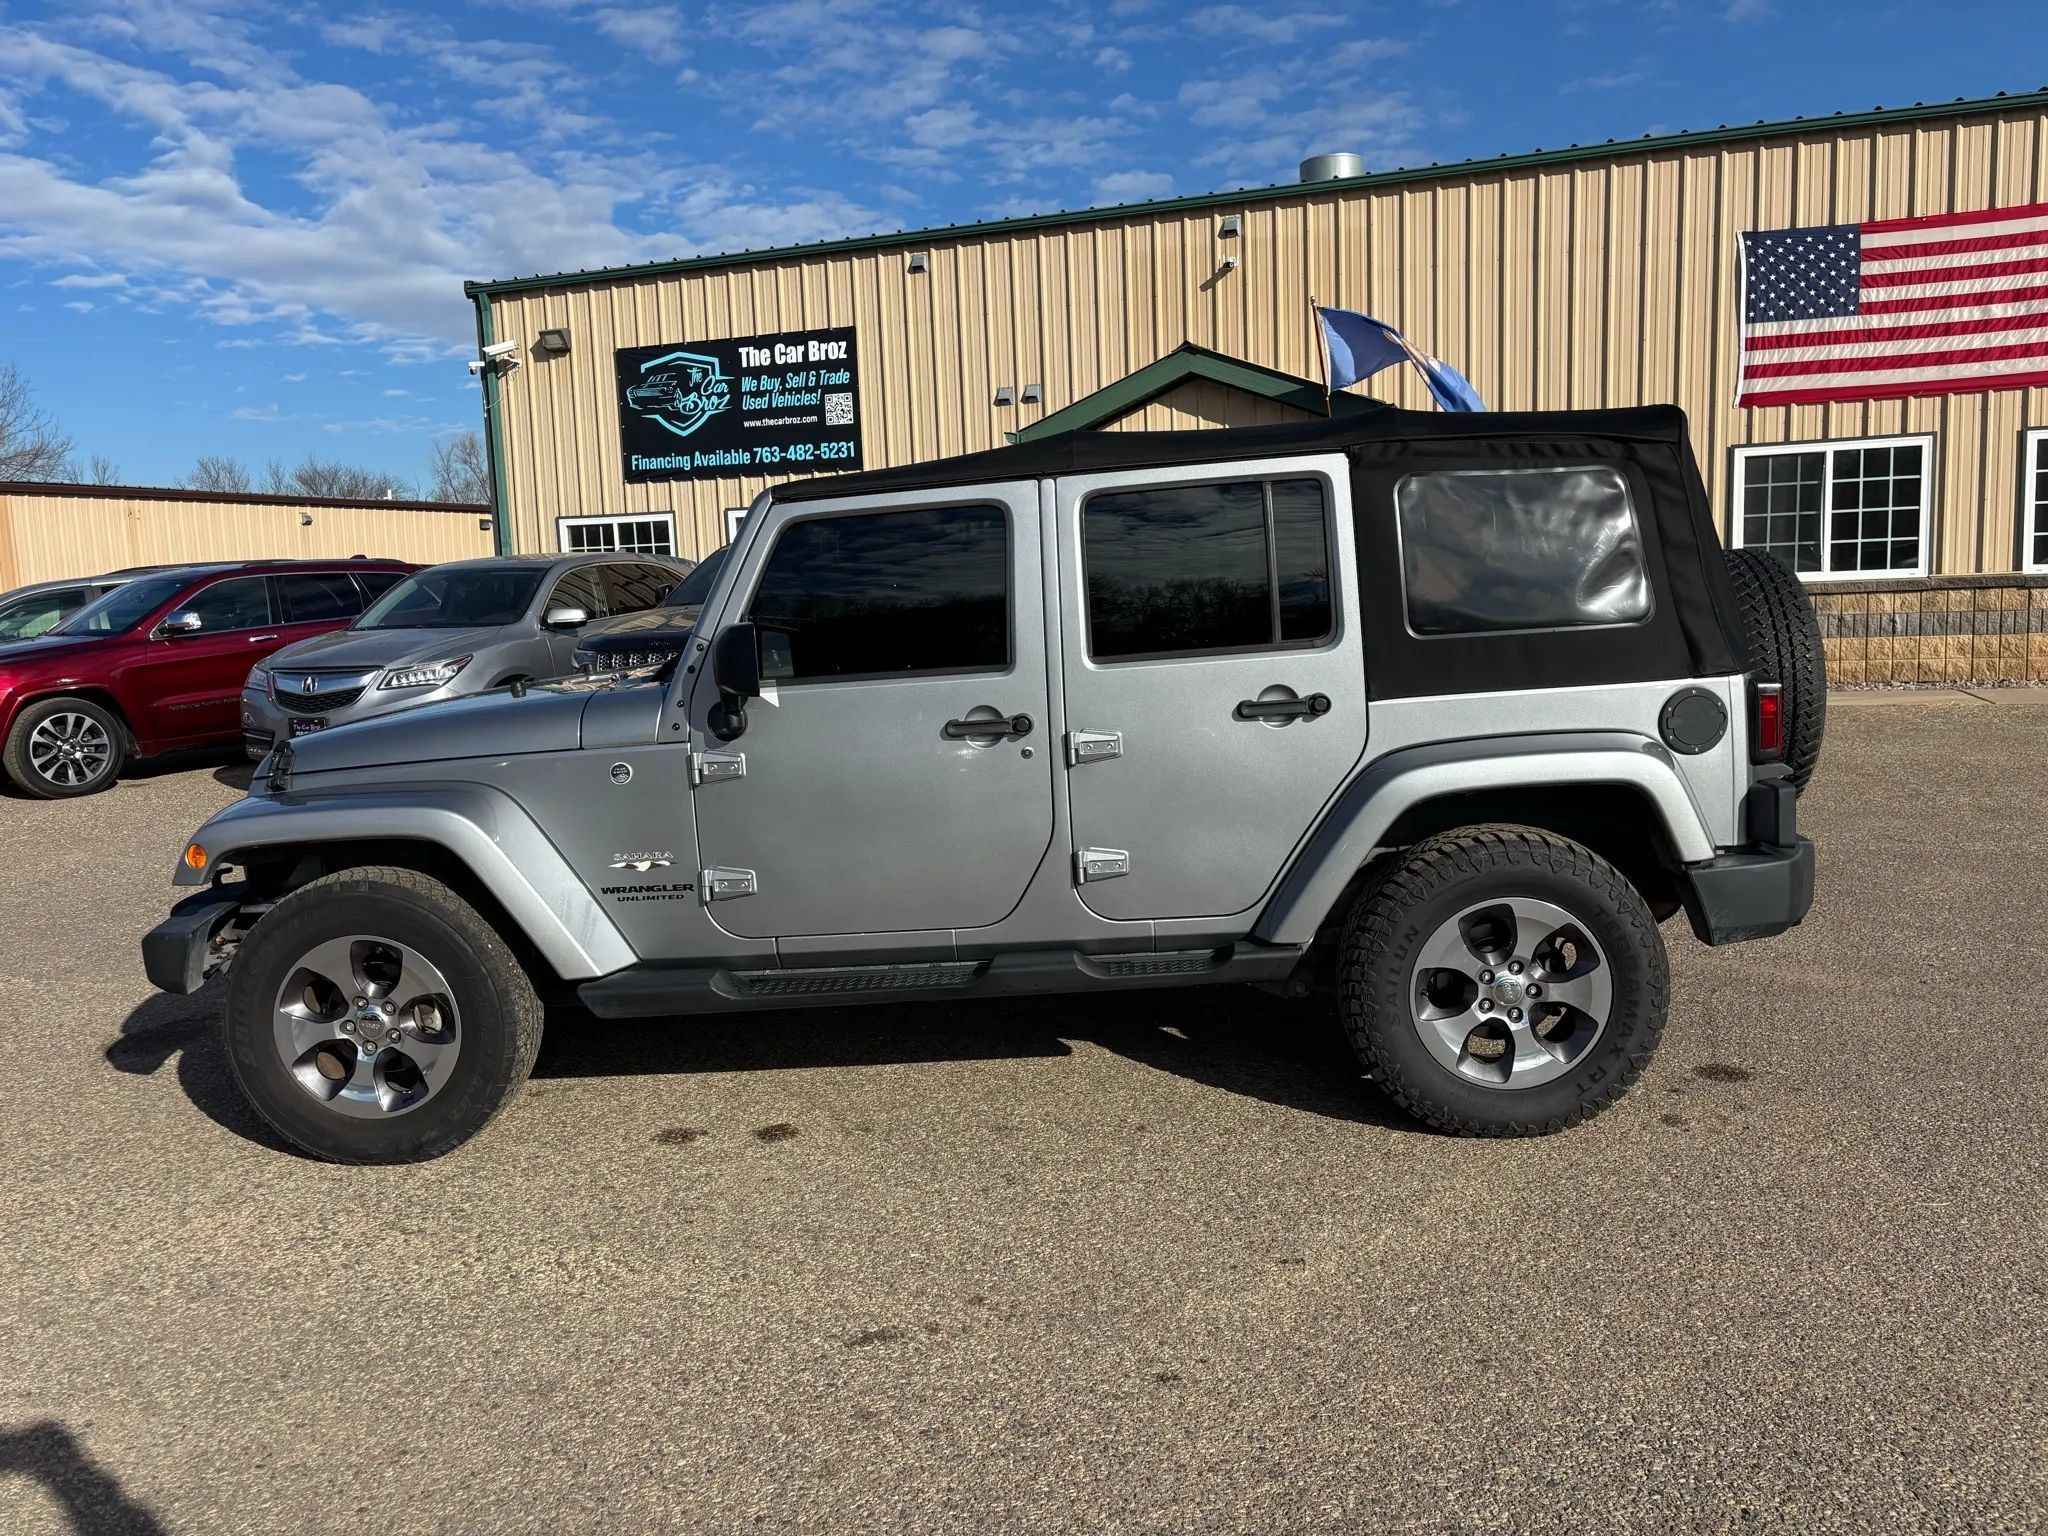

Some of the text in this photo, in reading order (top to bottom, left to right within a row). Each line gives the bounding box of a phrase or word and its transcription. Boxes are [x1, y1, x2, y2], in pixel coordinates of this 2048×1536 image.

[738, 340, 847, 368] The Car Broz
[701, 375, 729, 395] Car
[741, 368, 850, 392] We Buy, Sell & Trade
[742, 389, 822, 411] Used Vehicles!
[743, 416, 818, 428] www.thecarbroz.com
[631, 441, 855, 471] Financing Available 763-482-5231
[612, 850, 674, 860] SAHARA
[600, 883, 695, 894] WRANGLER
[617, 894, 685, 902] UNLIMITED
